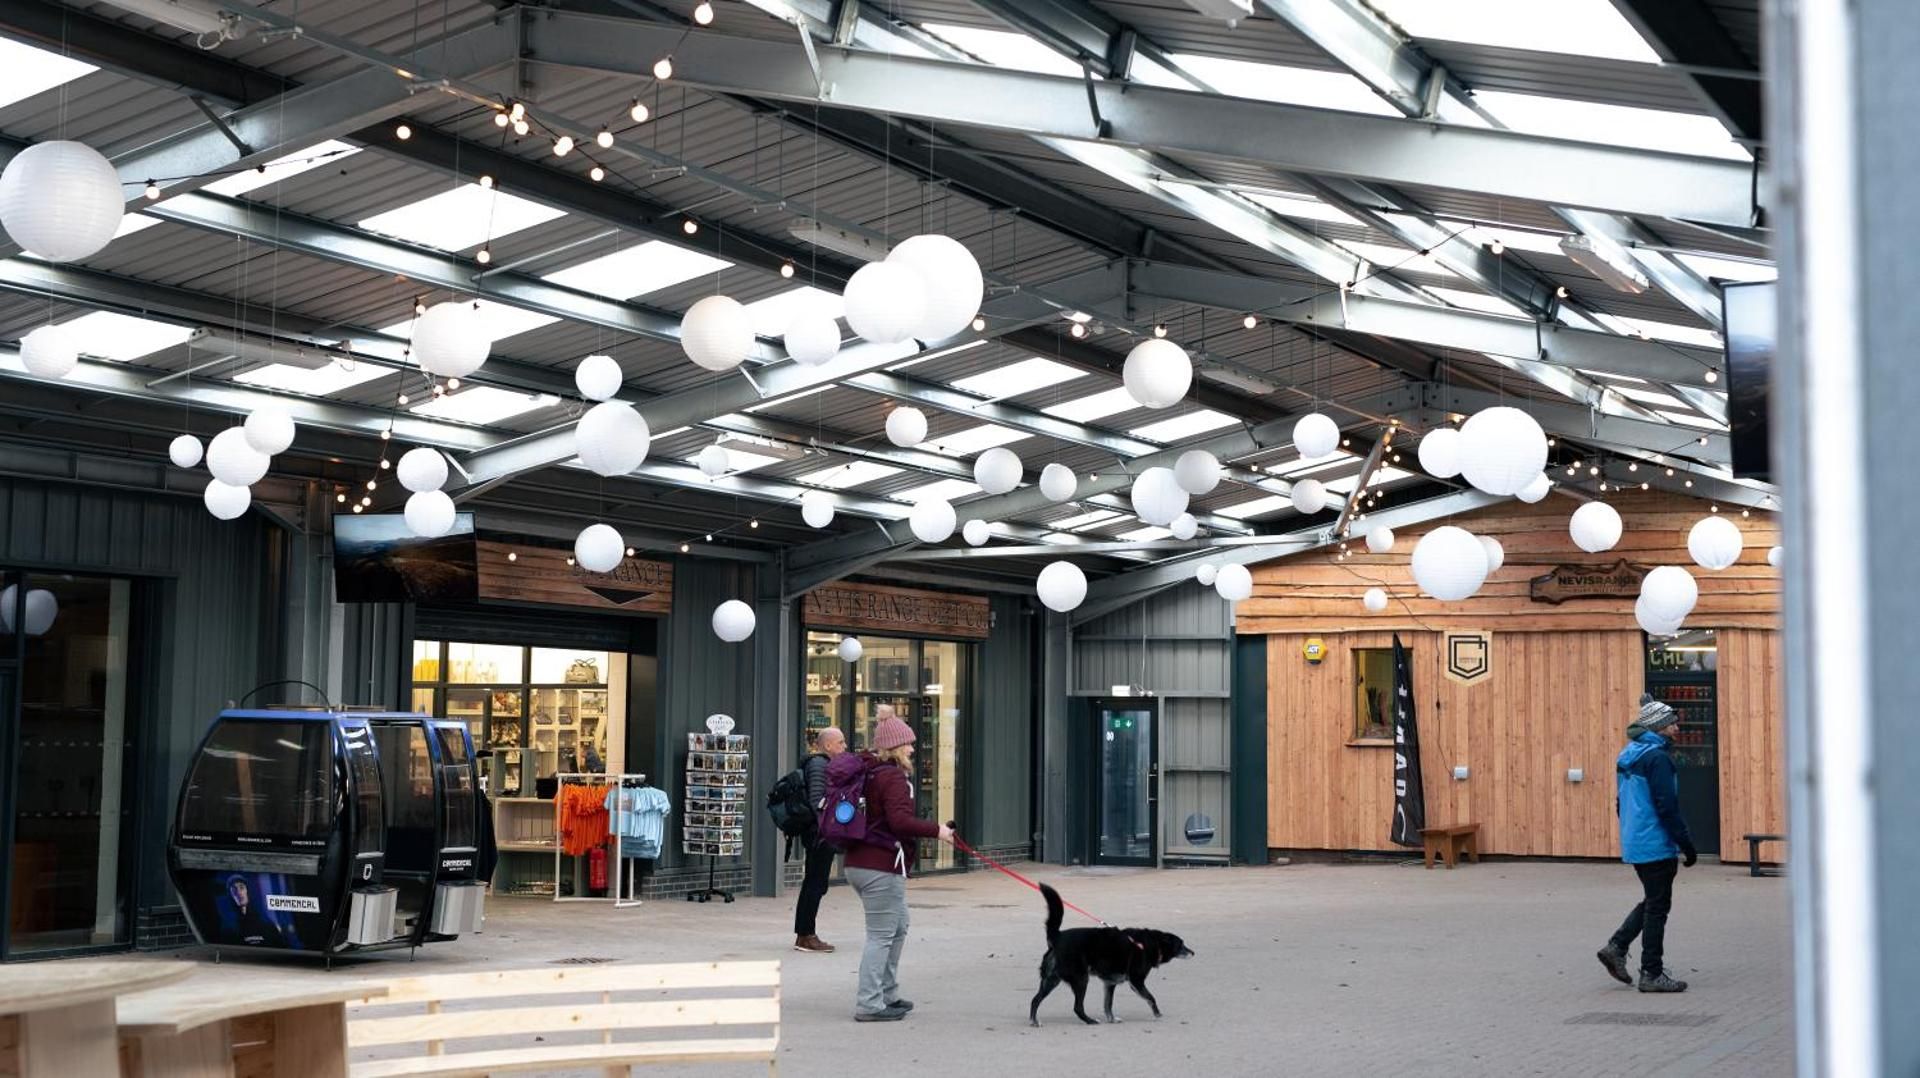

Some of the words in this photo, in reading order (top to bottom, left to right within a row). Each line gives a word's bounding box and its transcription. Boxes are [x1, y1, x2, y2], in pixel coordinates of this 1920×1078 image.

[807, 589, 861, 616] NEVIS
[866, 593, 921, 622] RANGE
[269, 898, 317, 909] COMMENCAL
